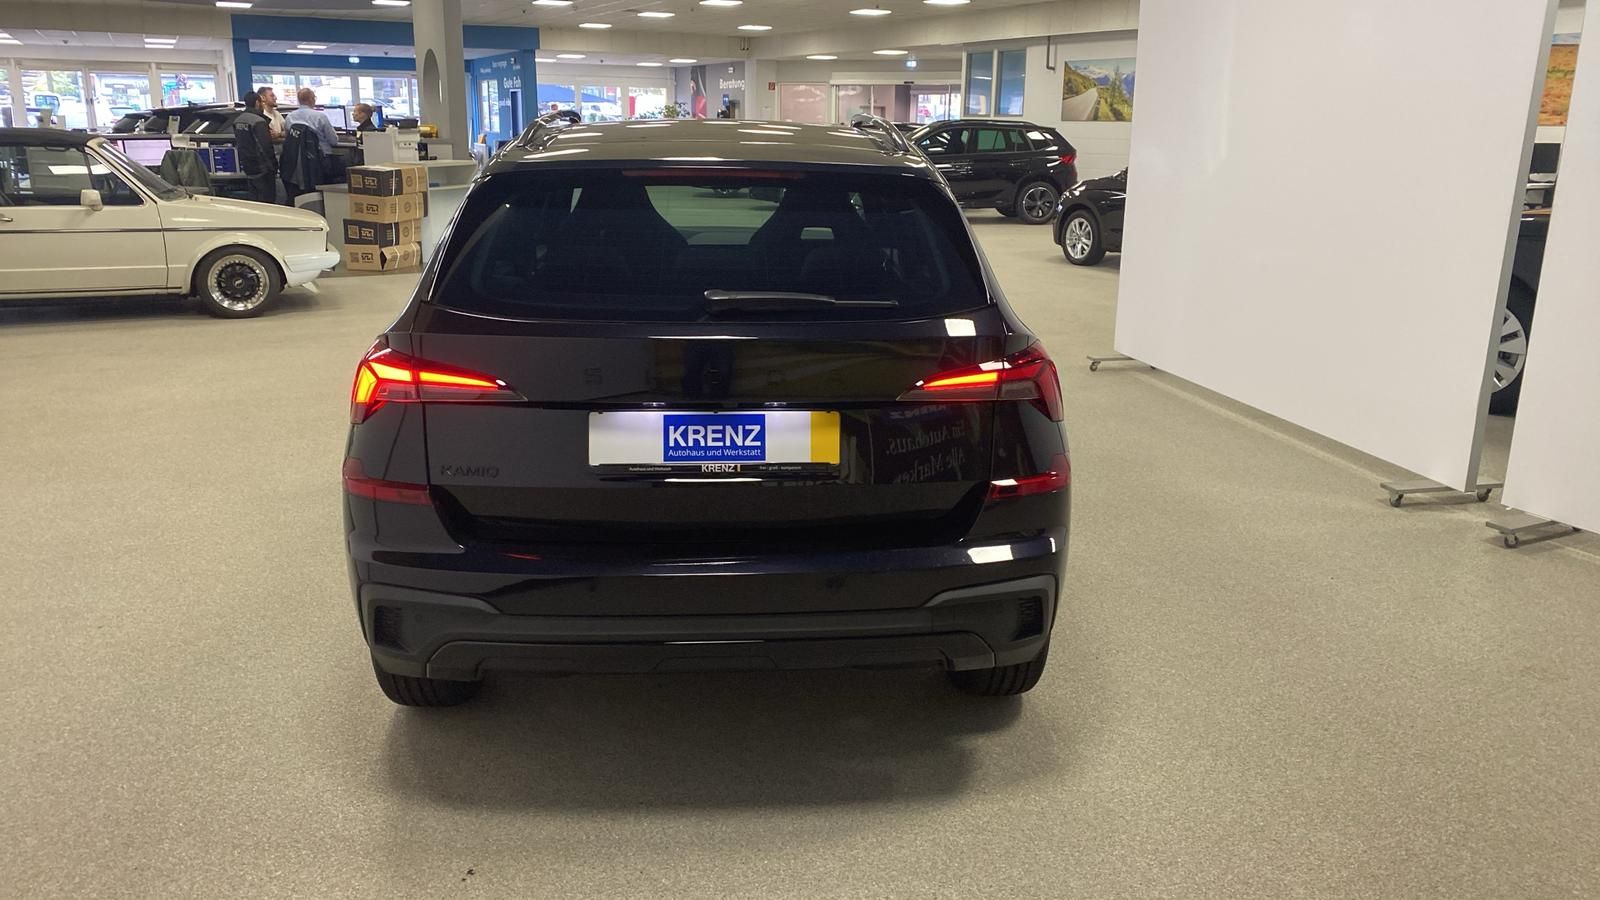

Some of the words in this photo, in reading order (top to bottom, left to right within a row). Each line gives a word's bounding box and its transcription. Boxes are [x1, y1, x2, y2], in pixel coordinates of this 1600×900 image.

[719, 78, 745, 91] Beratung
[668, 424, 761, 447] KRENZ
[668, 448, 705, 457] Autohaus
[706, 448, 722, 456] und
[723, 448, 761, 456] Werkstatt
[701, 464, 735, 472] KRENZ
